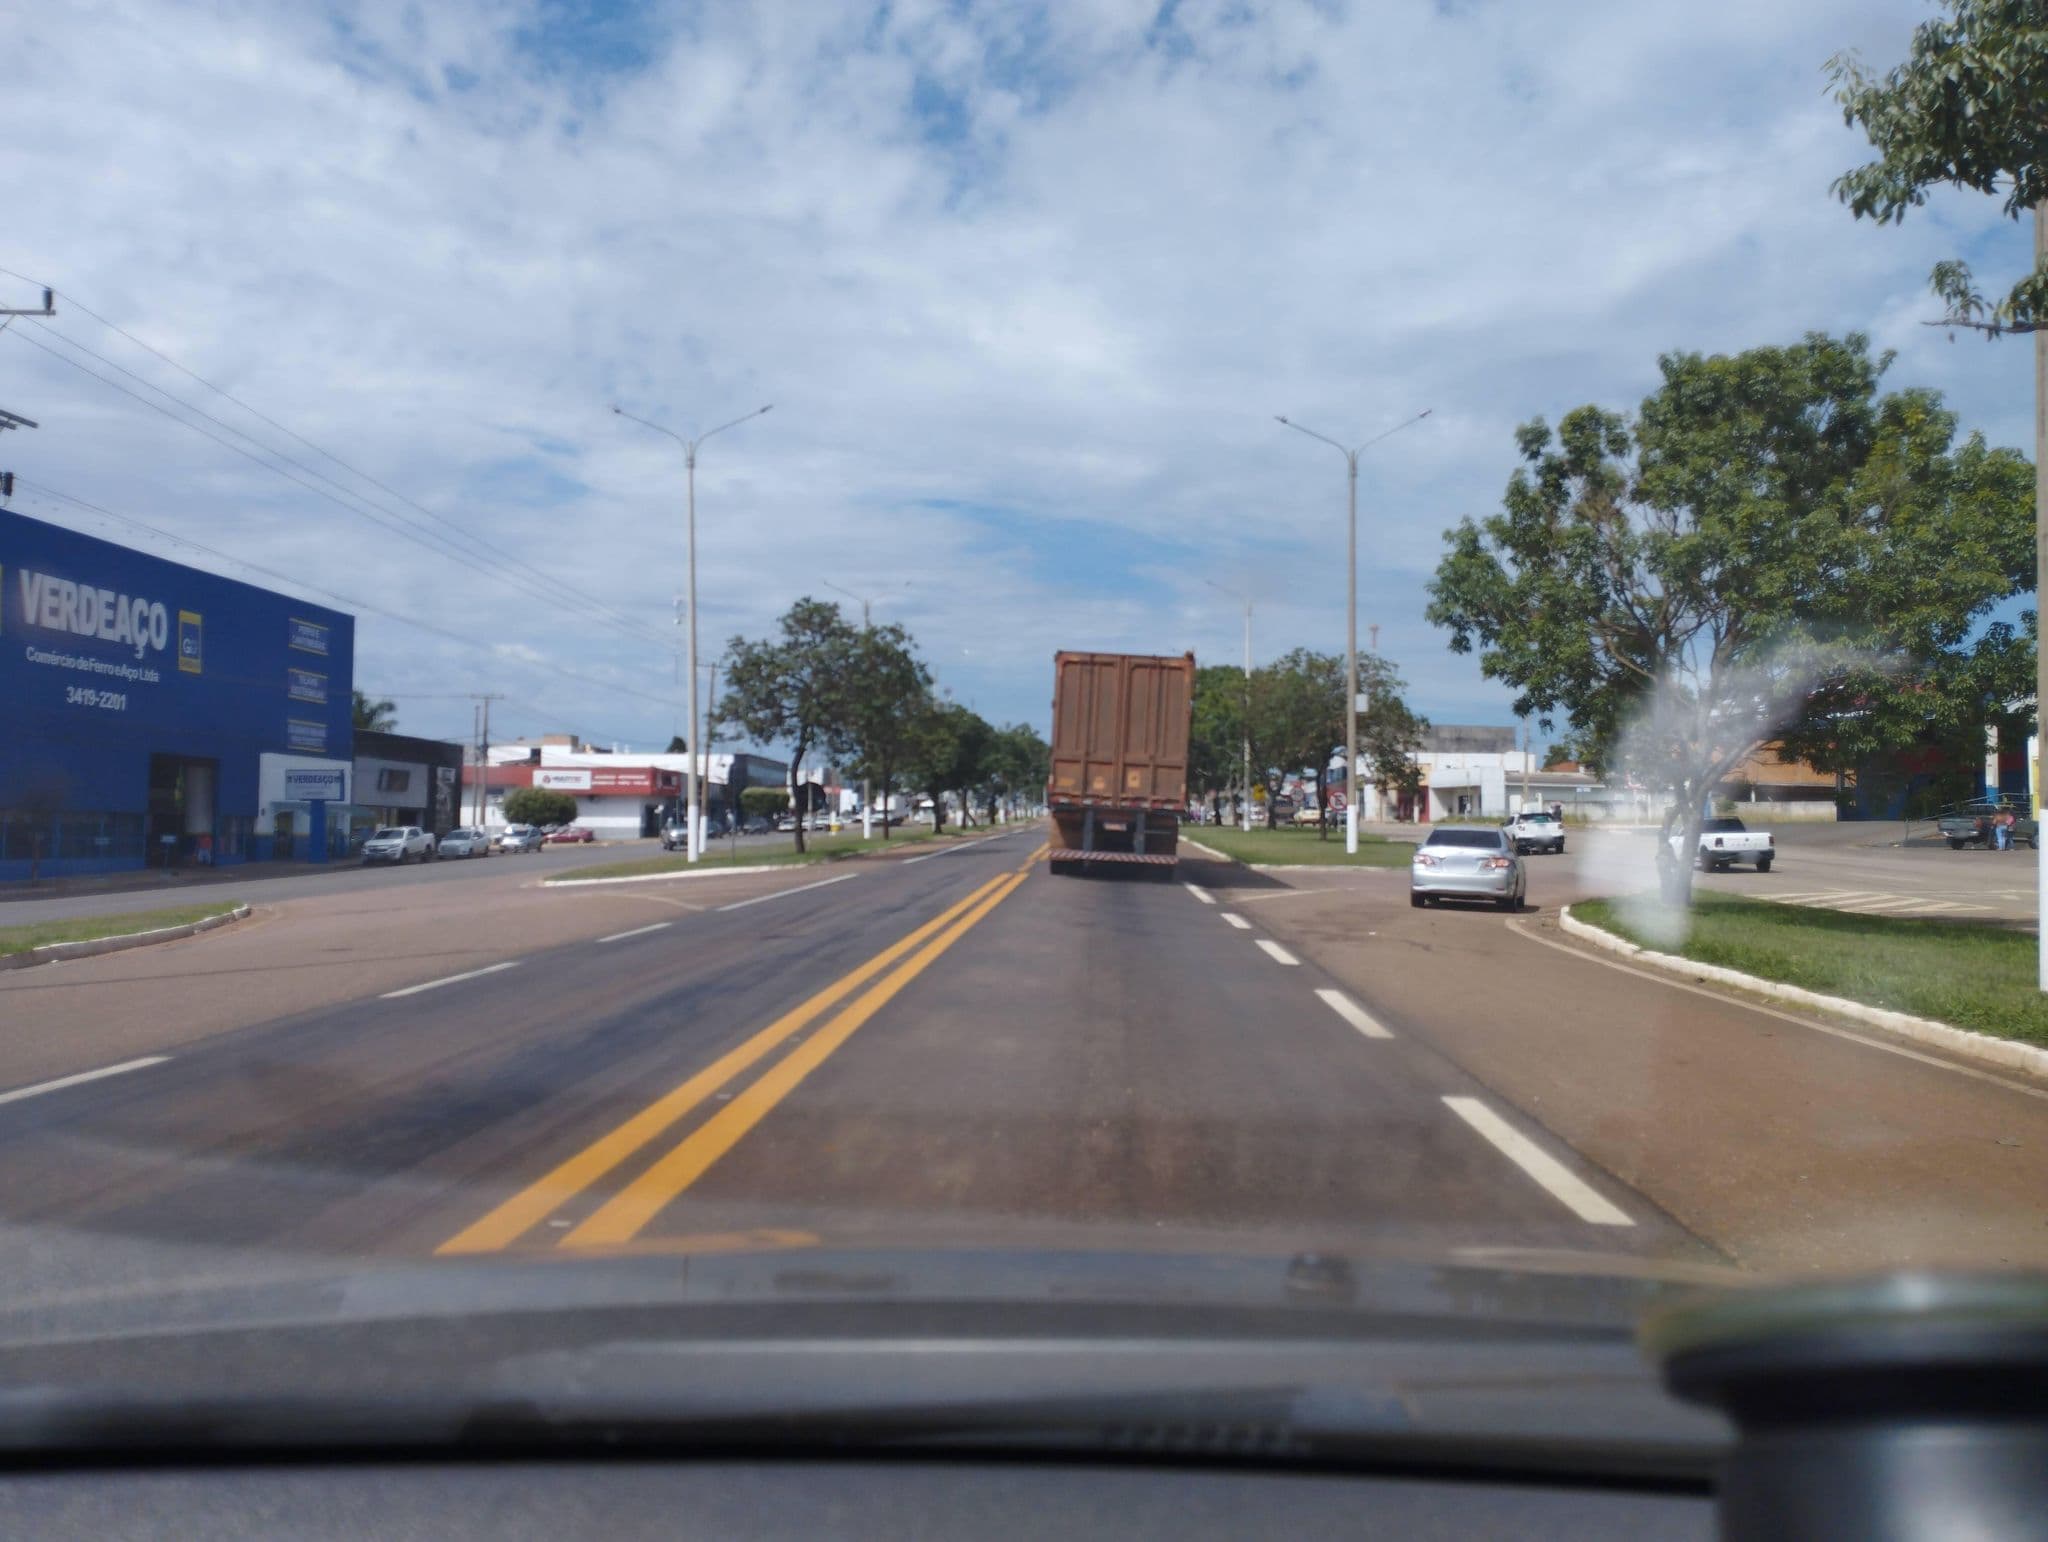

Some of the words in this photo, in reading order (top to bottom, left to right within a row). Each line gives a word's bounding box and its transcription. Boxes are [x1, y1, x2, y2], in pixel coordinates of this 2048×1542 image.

[19, 568, 168, 660] VERDEAÇO
[25, 646, 75, 668] Comércio
[76, 657, 88, 671] de
[88, 658, 113, 676] Ferro
[121, 664, 138, 682] Aço
[65, 686, 127, 711] 3419-2201
